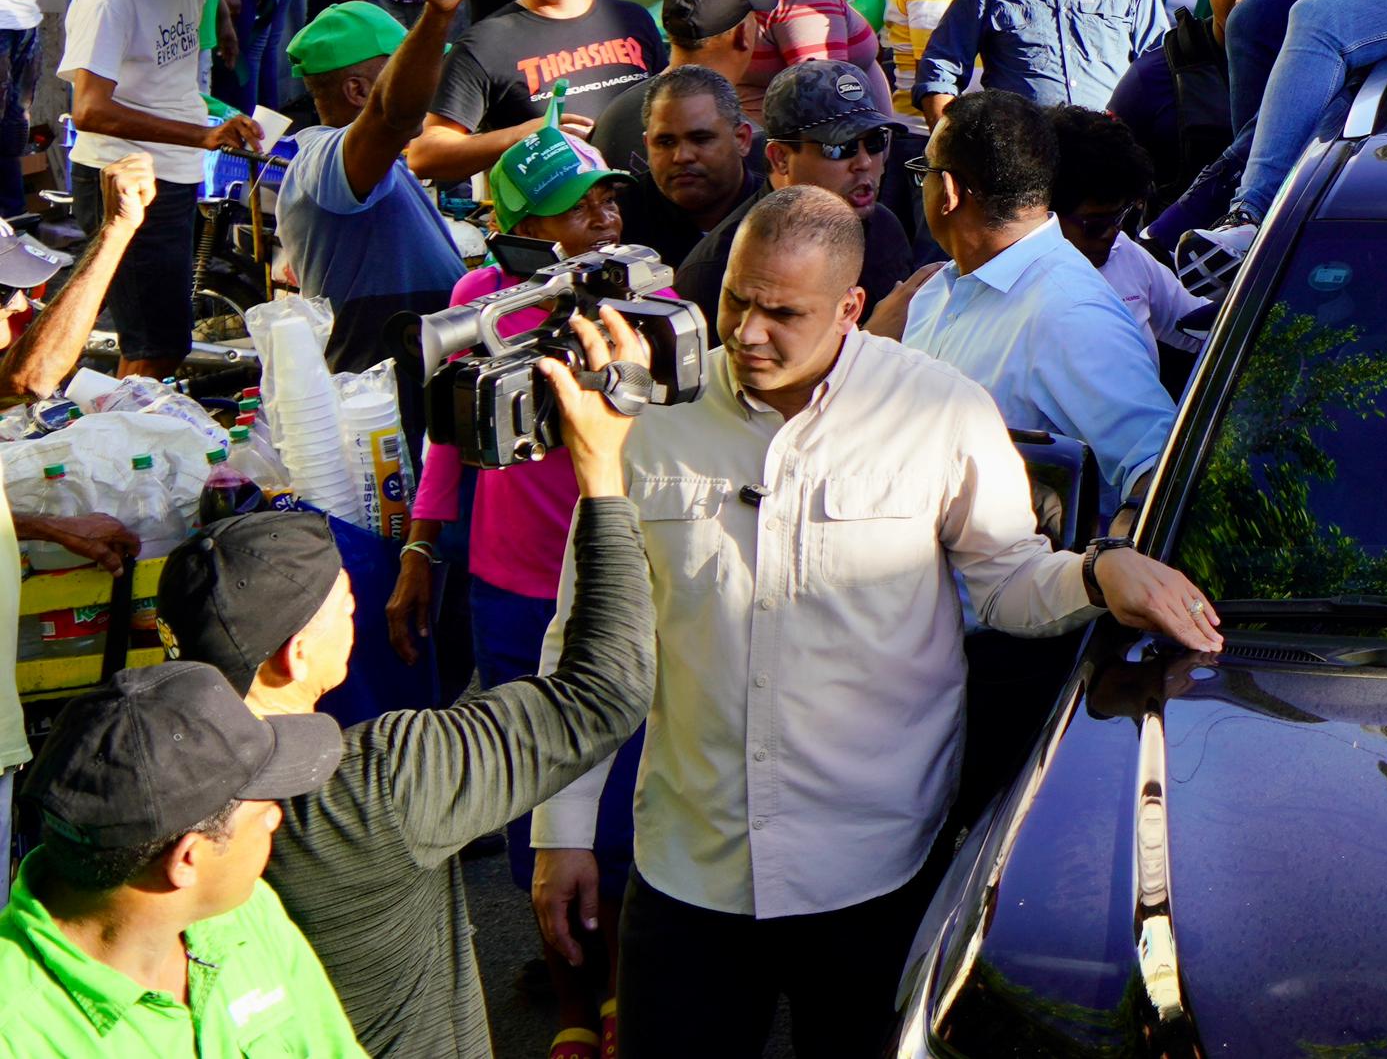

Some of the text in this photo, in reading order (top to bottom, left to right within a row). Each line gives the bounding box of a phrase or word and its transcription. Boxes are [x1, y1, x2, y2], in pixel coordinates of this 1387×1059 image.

[157, 42, 178, 65] EVERY
[517, 36, 648, 95] THRASHER
[389, 479, 401, 497] 12
